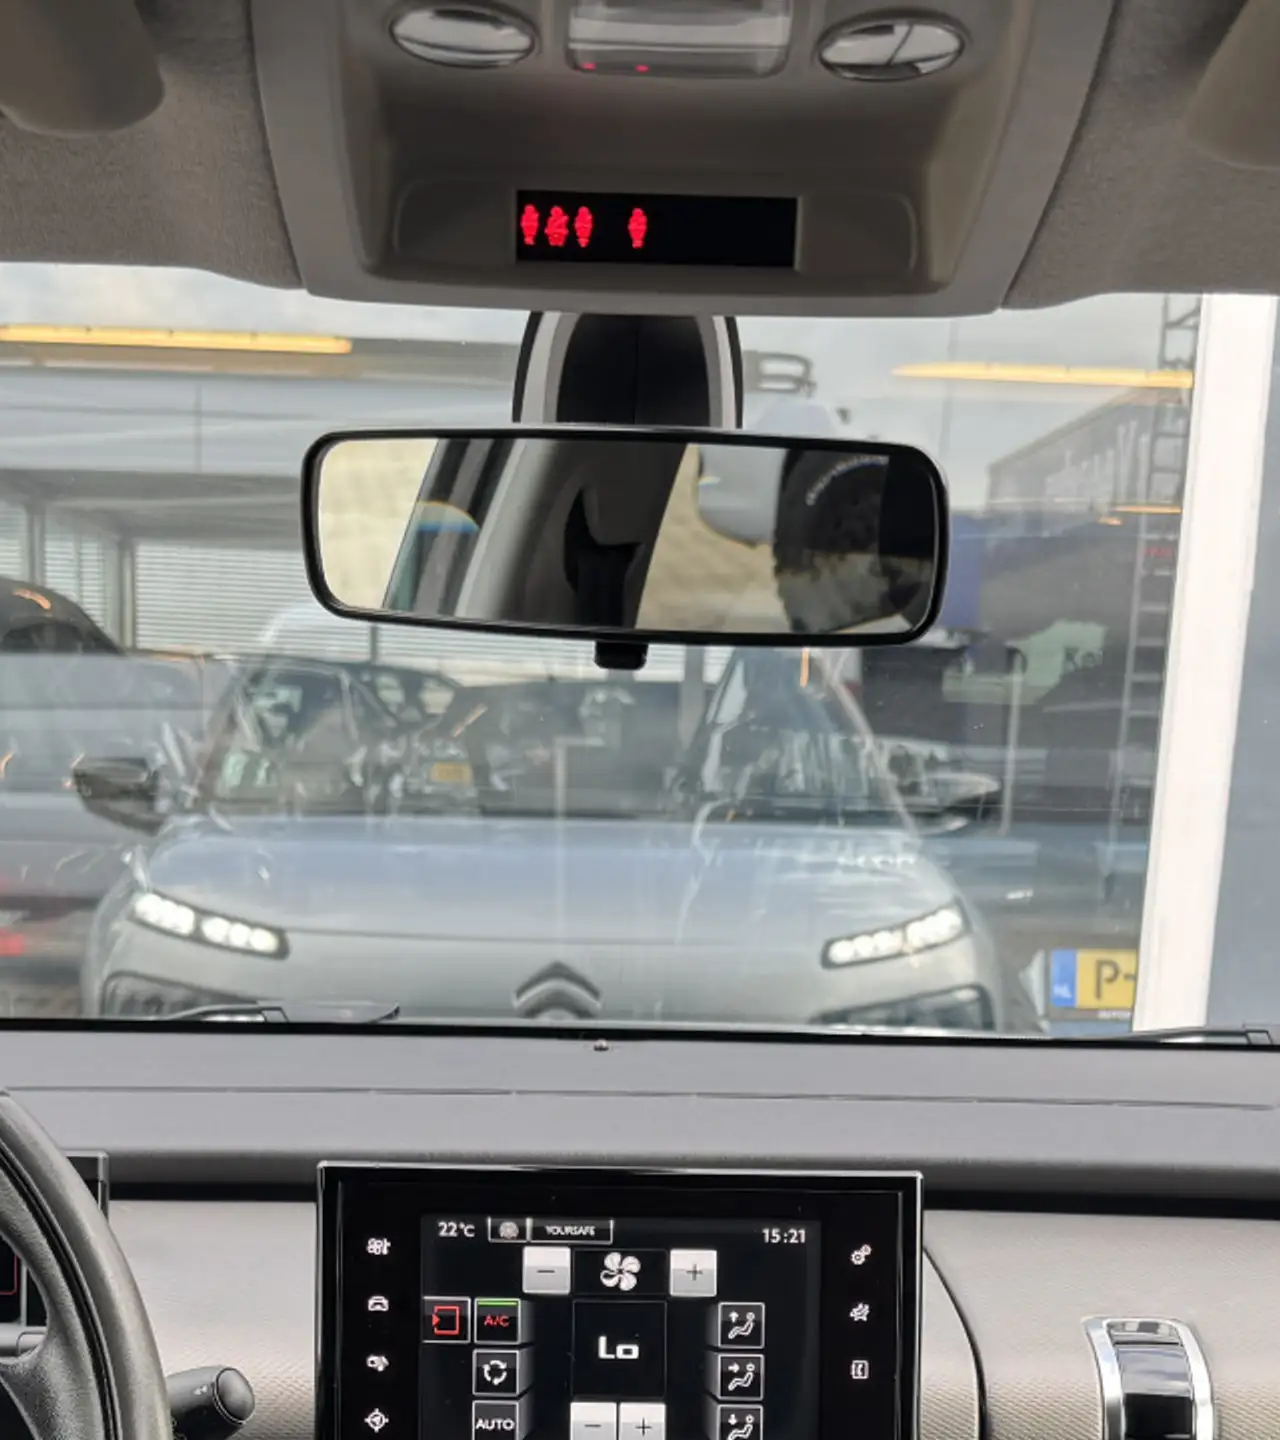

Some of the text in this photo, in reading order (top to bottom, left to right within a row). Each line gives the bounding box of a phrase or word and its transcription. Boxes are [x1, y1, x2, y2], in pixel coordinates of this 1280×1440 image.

[438, 1222, 475, 1237] 22°C
[762, 1229, 806, 1244] 15:21
[484, 1314, 509, 1327] A/C
[597, 1335, 640, 1360] Lo
[475, 1418, 515, 1431] AUTO
